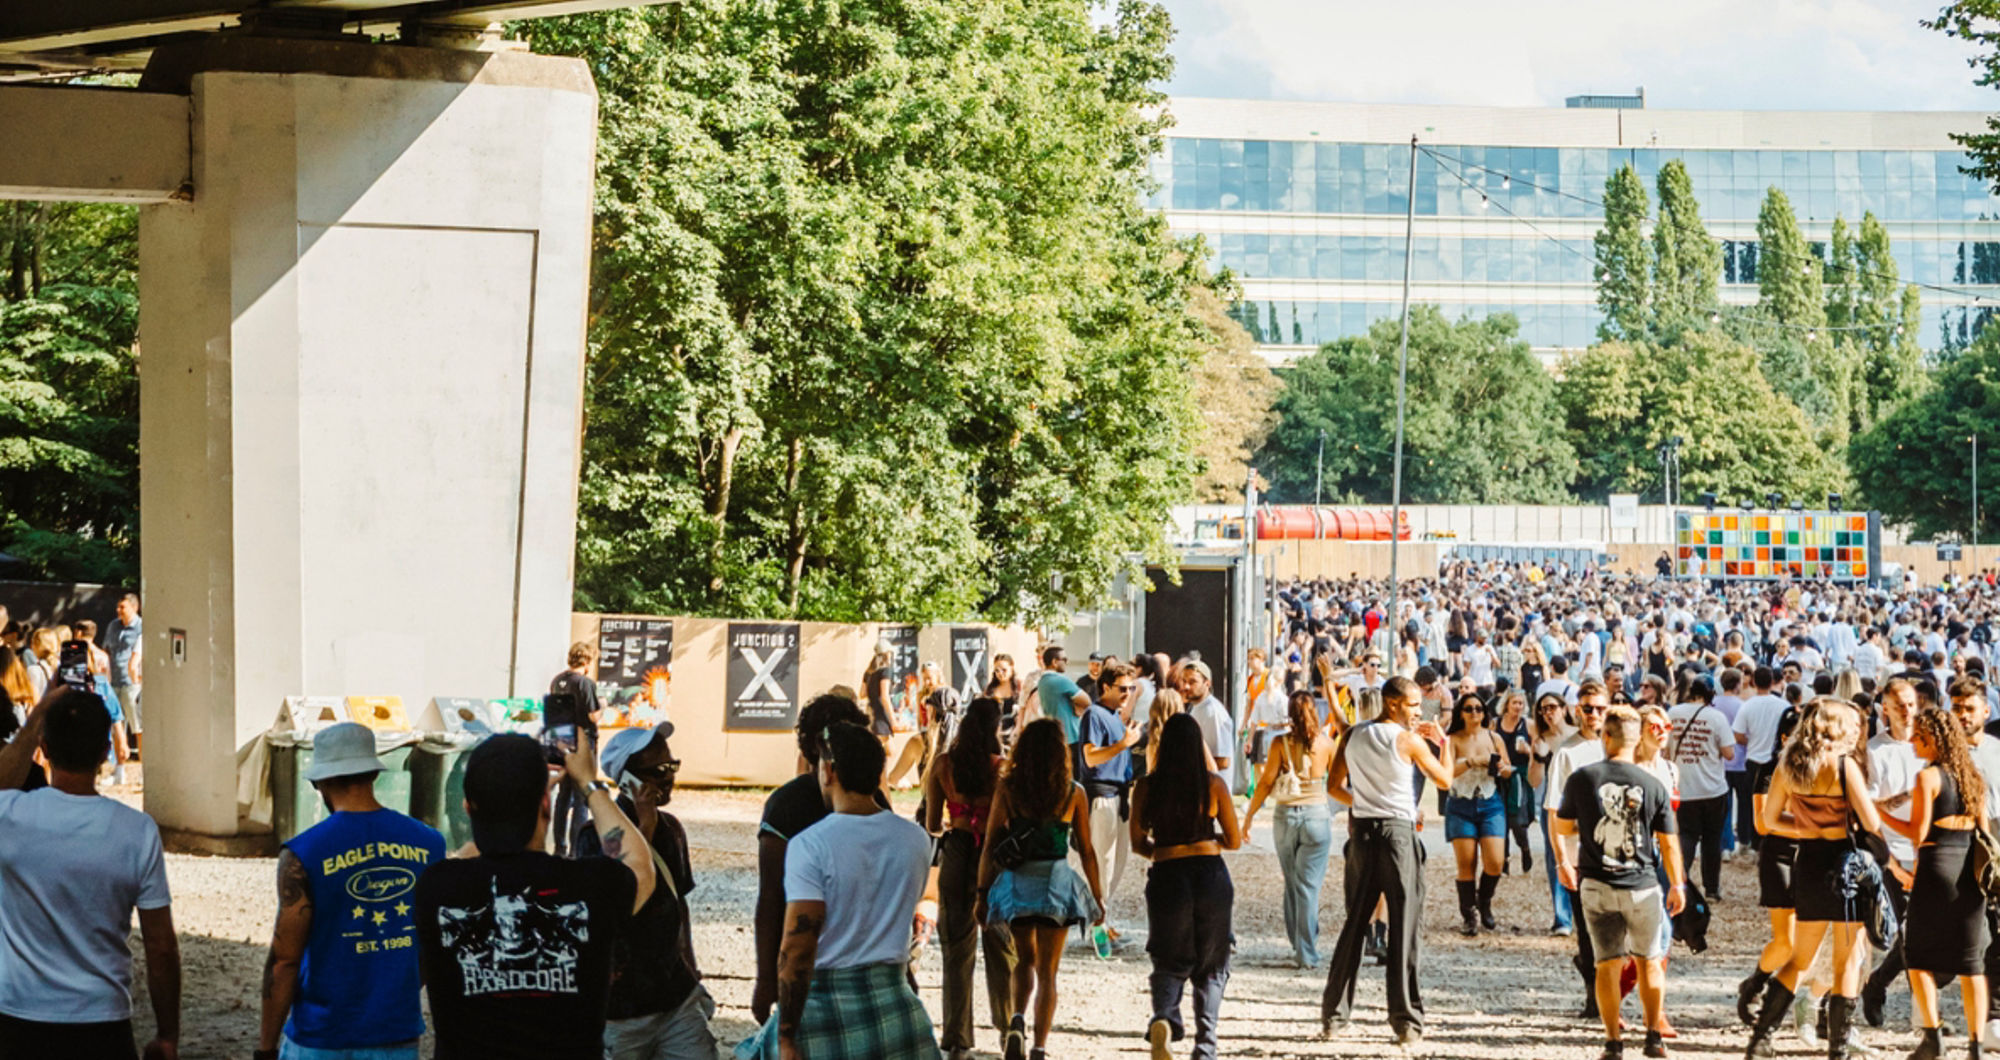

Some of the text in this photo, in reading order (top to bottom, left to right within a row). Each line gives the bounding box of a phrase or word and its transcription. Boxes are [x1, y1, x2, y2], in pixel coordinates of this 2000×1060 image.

[733, 633, 795, 647] JUNCTION 2
[738, 648, 788, 701] X
[323, 842, 430, 876] EAGLE POINT
[352, 874, 409, 897] Oregon
[356, 935, 413, 953] EST. 1998
[463, 962, 579, 996] HARDCORE
